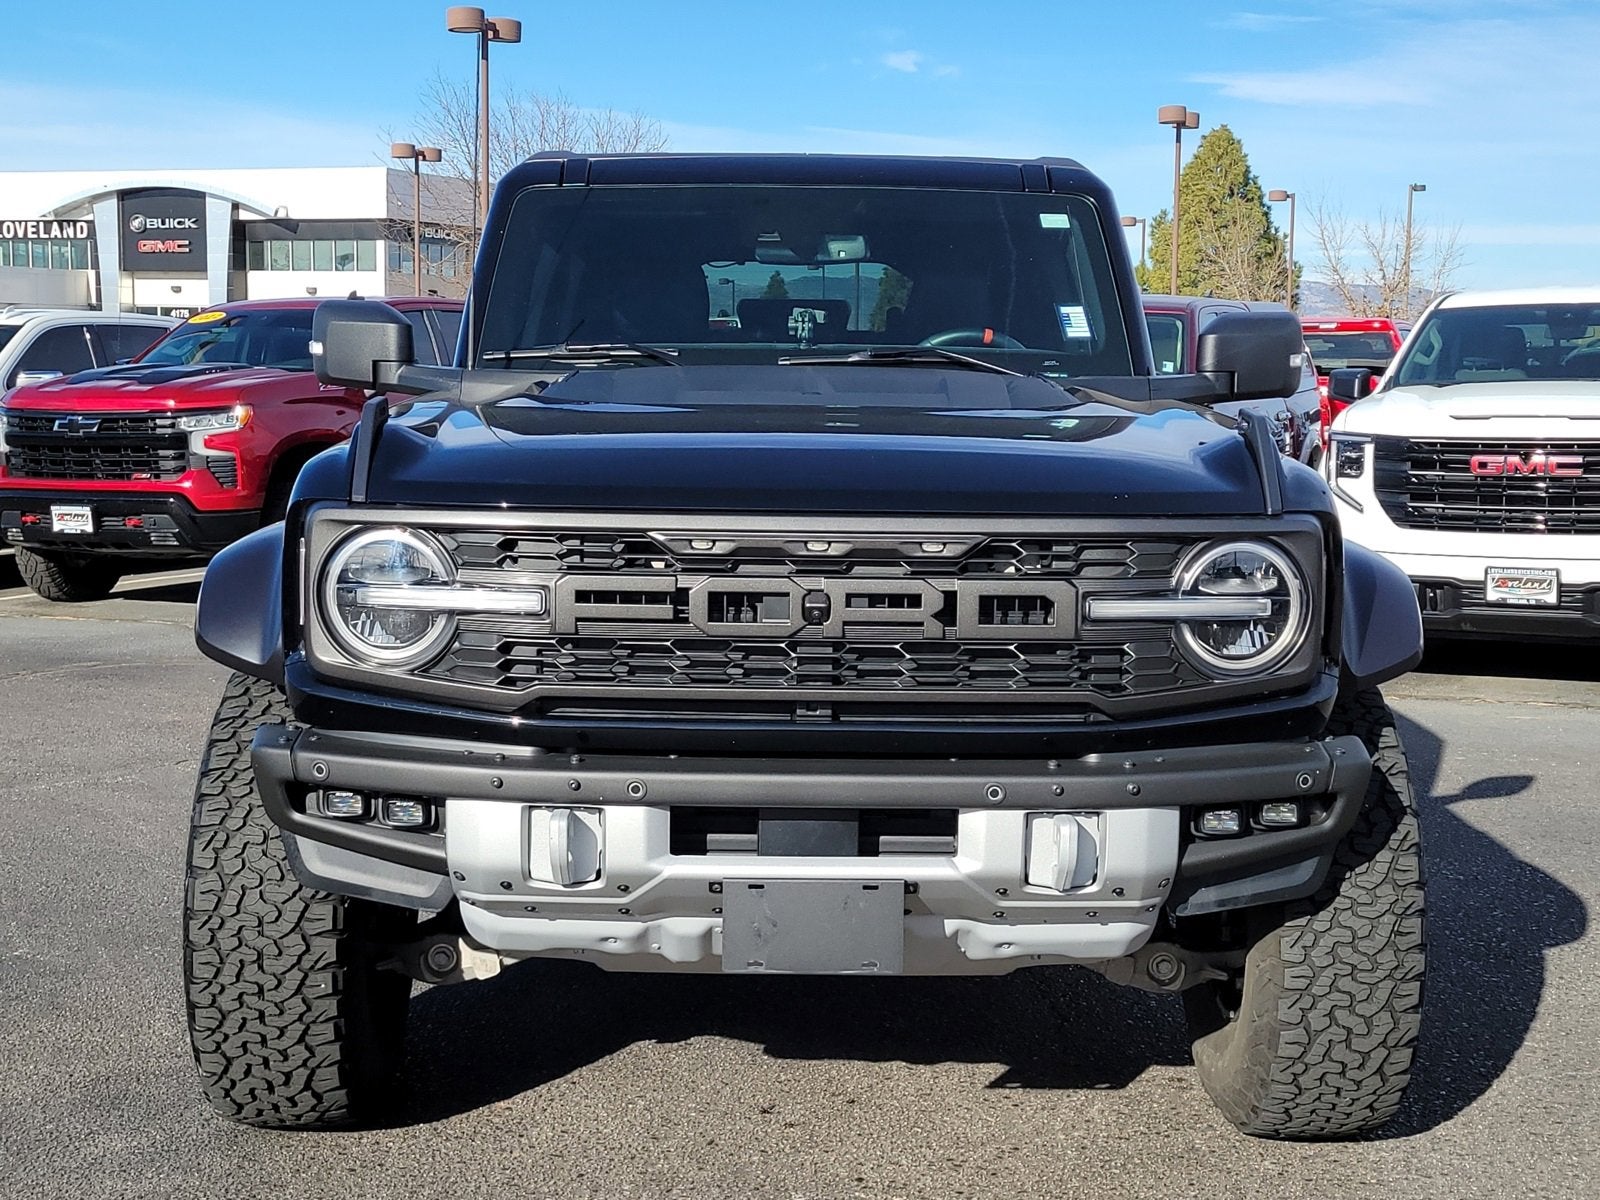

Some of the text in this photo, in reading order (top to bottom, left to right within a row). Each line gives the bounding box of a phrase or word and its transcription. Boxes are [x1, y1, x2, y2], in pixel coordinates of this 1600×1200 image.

[146, 217, 199, 229] BUICK
[138, 240, 190, 253] GMC
[170, 309, 190, 318] 4175
[1470, 454, 1584, 476] GMC
[553, 575, 1079, 639] FORD
